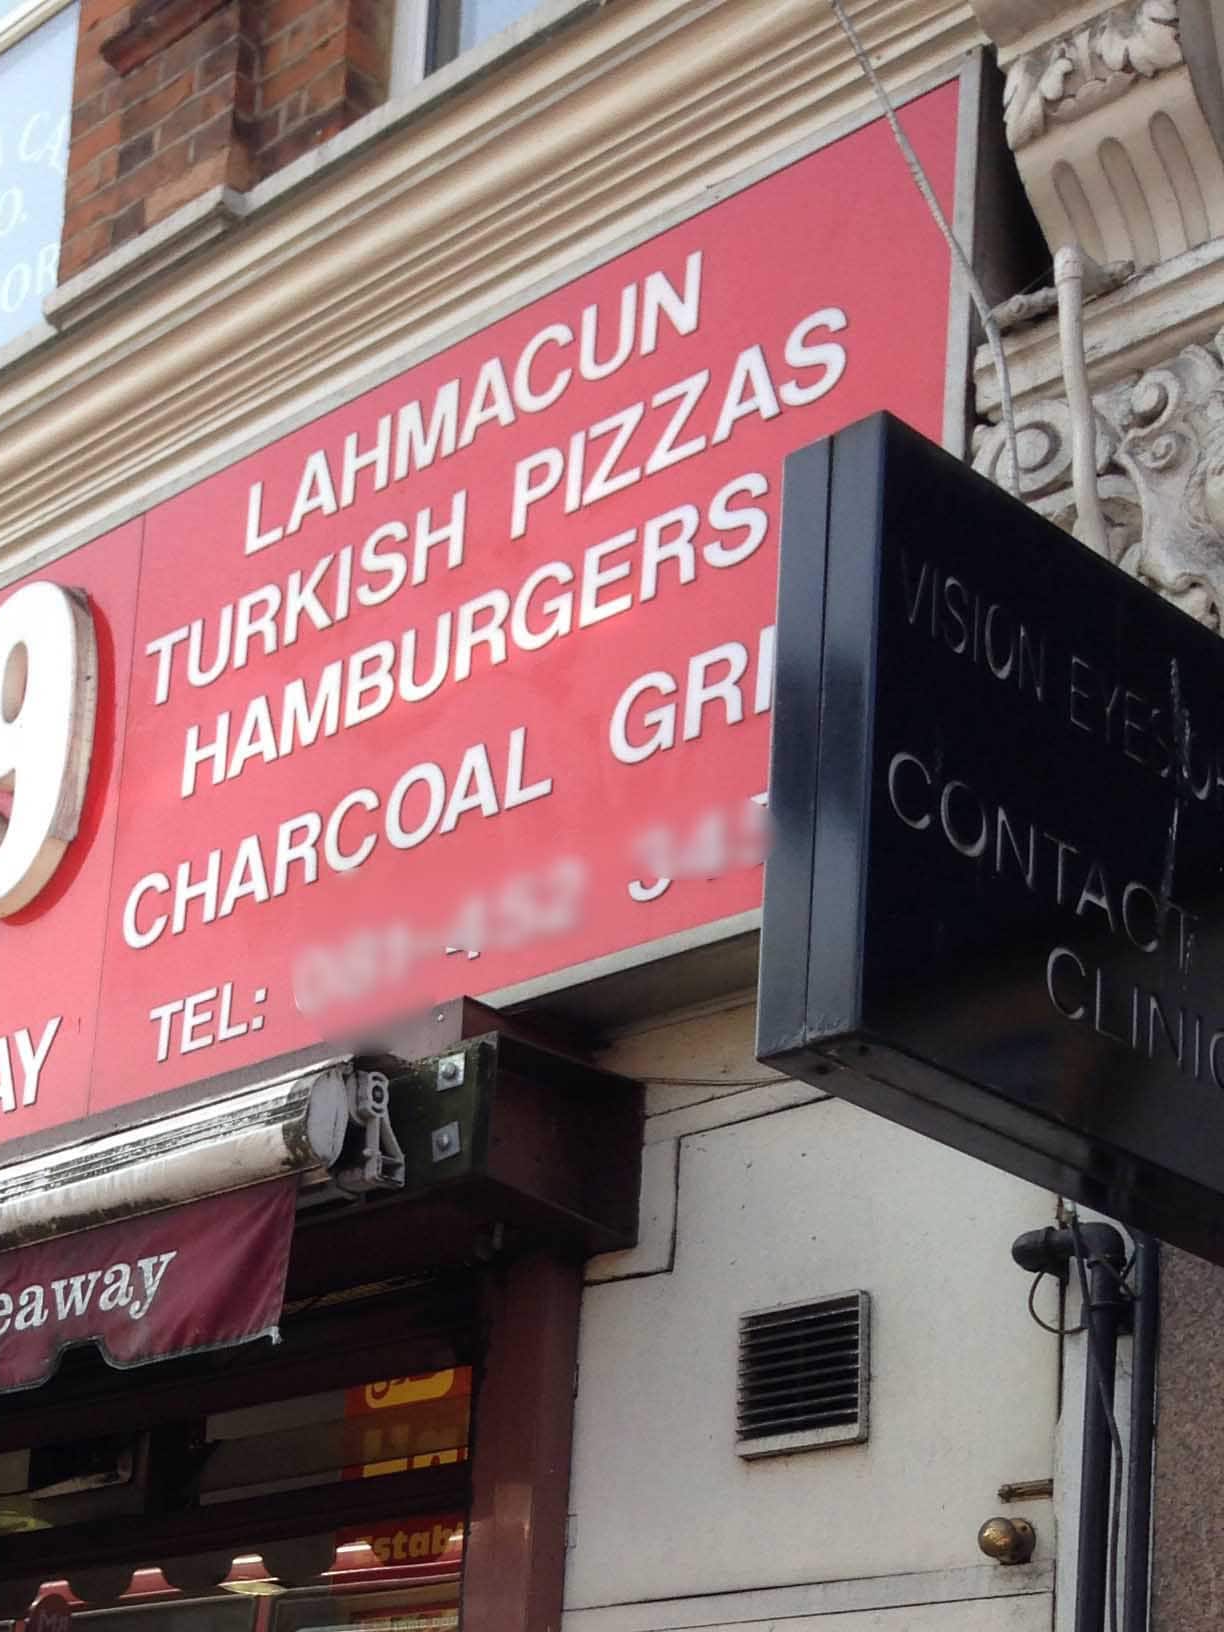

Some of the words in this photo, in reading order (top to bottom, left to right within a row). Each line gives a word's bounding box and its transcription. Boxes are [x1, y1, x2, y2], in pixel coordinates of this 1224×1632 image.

[145, 490, 468, 706] TURKISH
[511, 306, 848, 541] PIZZAS
[244, 250, 704, 556] LAHMACUN
[180, 474, 772, 799] HAMBURGERS
[899, 550, 1048, 706] VISION
[122, 726, 554, 949] CHARCOAL
[886, 750, 1200, 972] CONTACT
[149, 986, 268, 1064] TEL:
